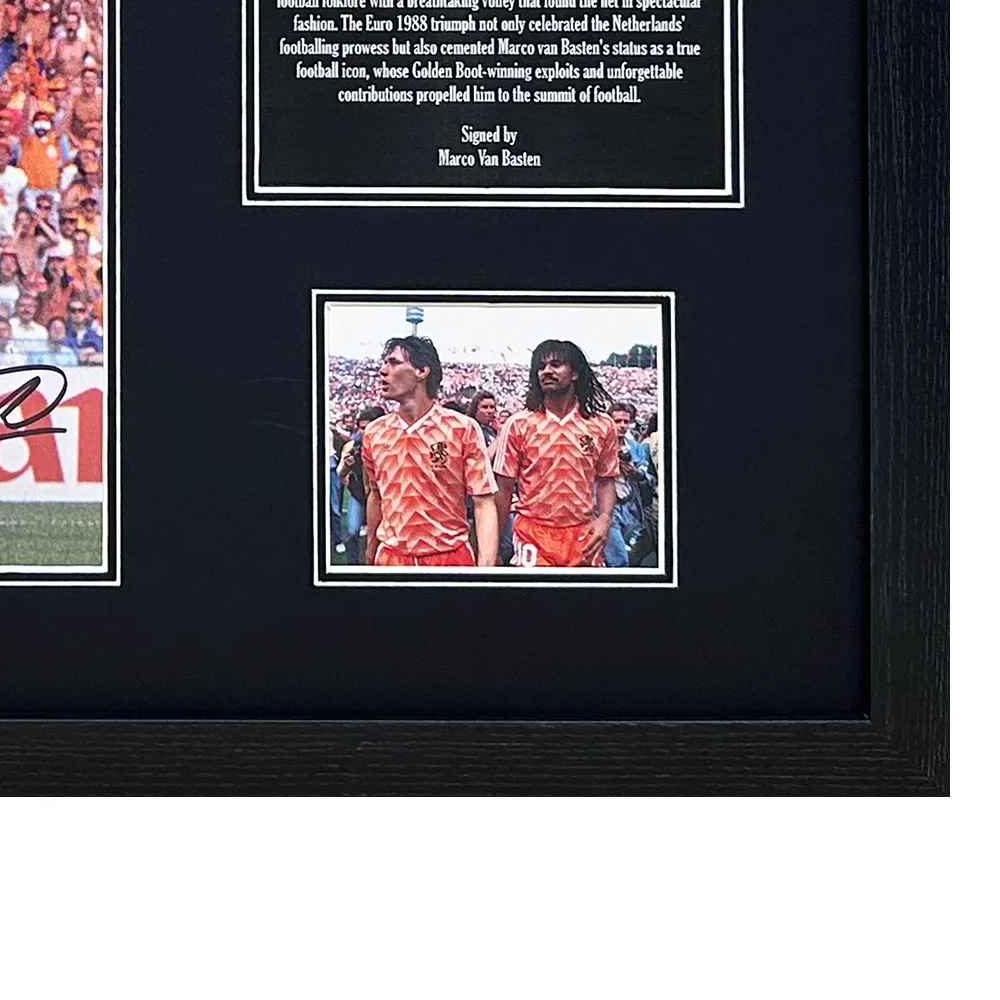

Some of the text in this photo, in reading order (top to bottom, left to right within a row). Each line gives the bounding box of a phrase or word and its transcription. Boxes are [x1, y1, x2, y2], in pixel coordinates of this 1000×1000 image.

[294, 14, 685, 34] fashion. The Euro 1988 triumph not only celebrated the Netherlands'
[279, 38, 701, 57] footballing prowess but also cemented Marco van Basten's status as a true
[296, 61, 683, 82] football icon, whose Golden Boot-winning exploits and unforgettable
[338, 85, 641, 105] contributions propelled him to the summit of football.
[461, 125, 518, 145] Signed by
[438, 149, 541, 166] Marco Van Basten
